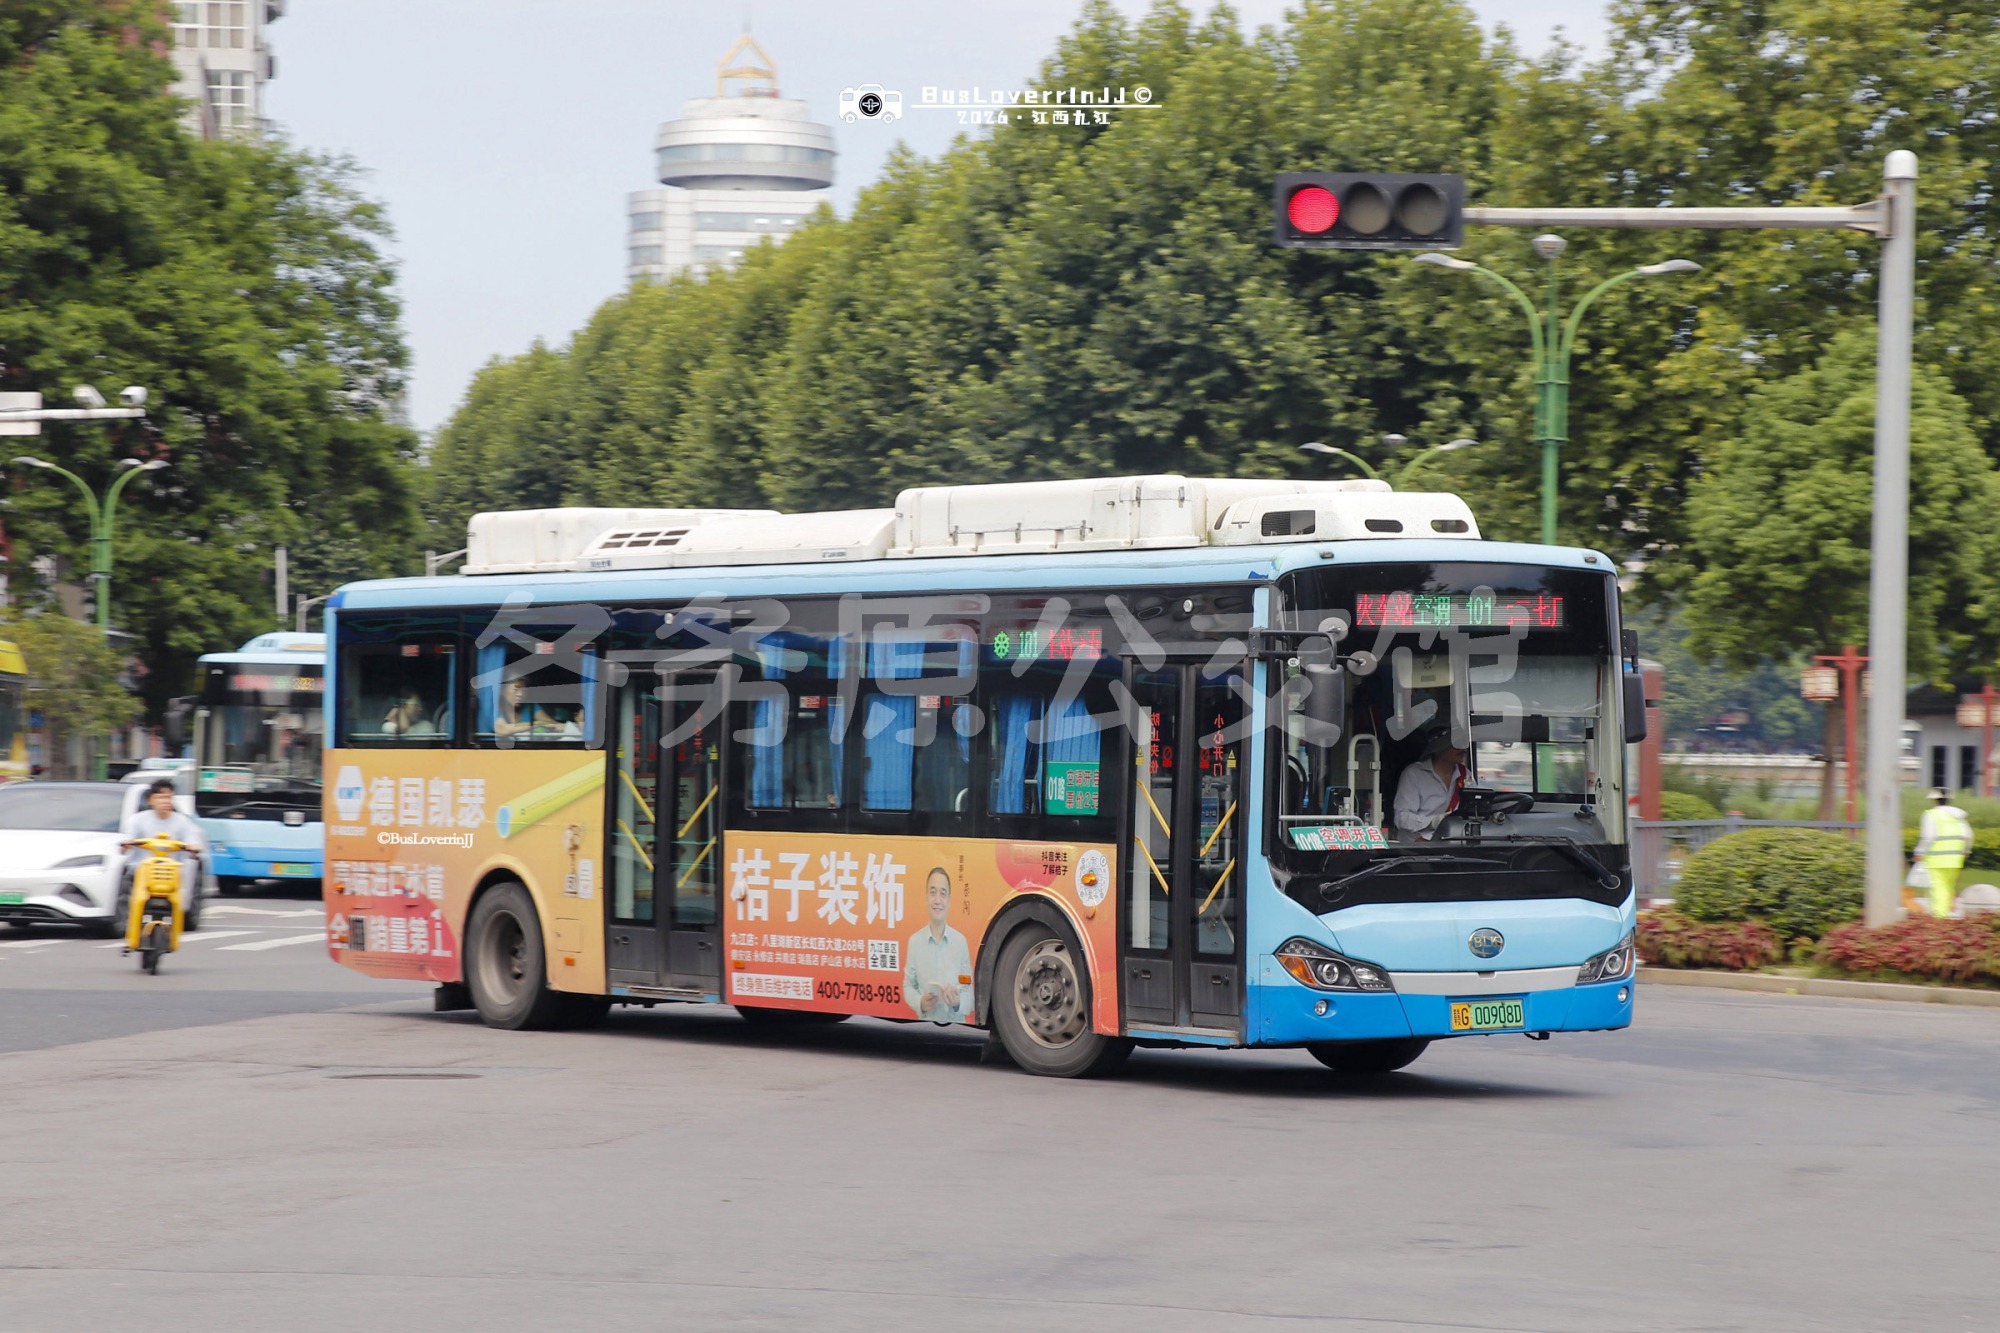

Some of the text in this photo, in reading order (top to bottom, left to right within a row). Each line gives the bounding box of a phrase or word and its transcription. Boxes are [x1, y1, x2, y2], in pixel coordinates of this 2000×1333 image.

[1466, 596, 1492, 625] 101
[1019, 630, 1039, 658] 101
[369, 776, 487, 828] 德国凯瑟
[1319, 827, 1383, 842] 空调开启
[730, 848, 907, 929] 桔子装饰
[329, 908, 453, 958] 全销量第1
[817, 981, 900, 1003] 400-7788-985
